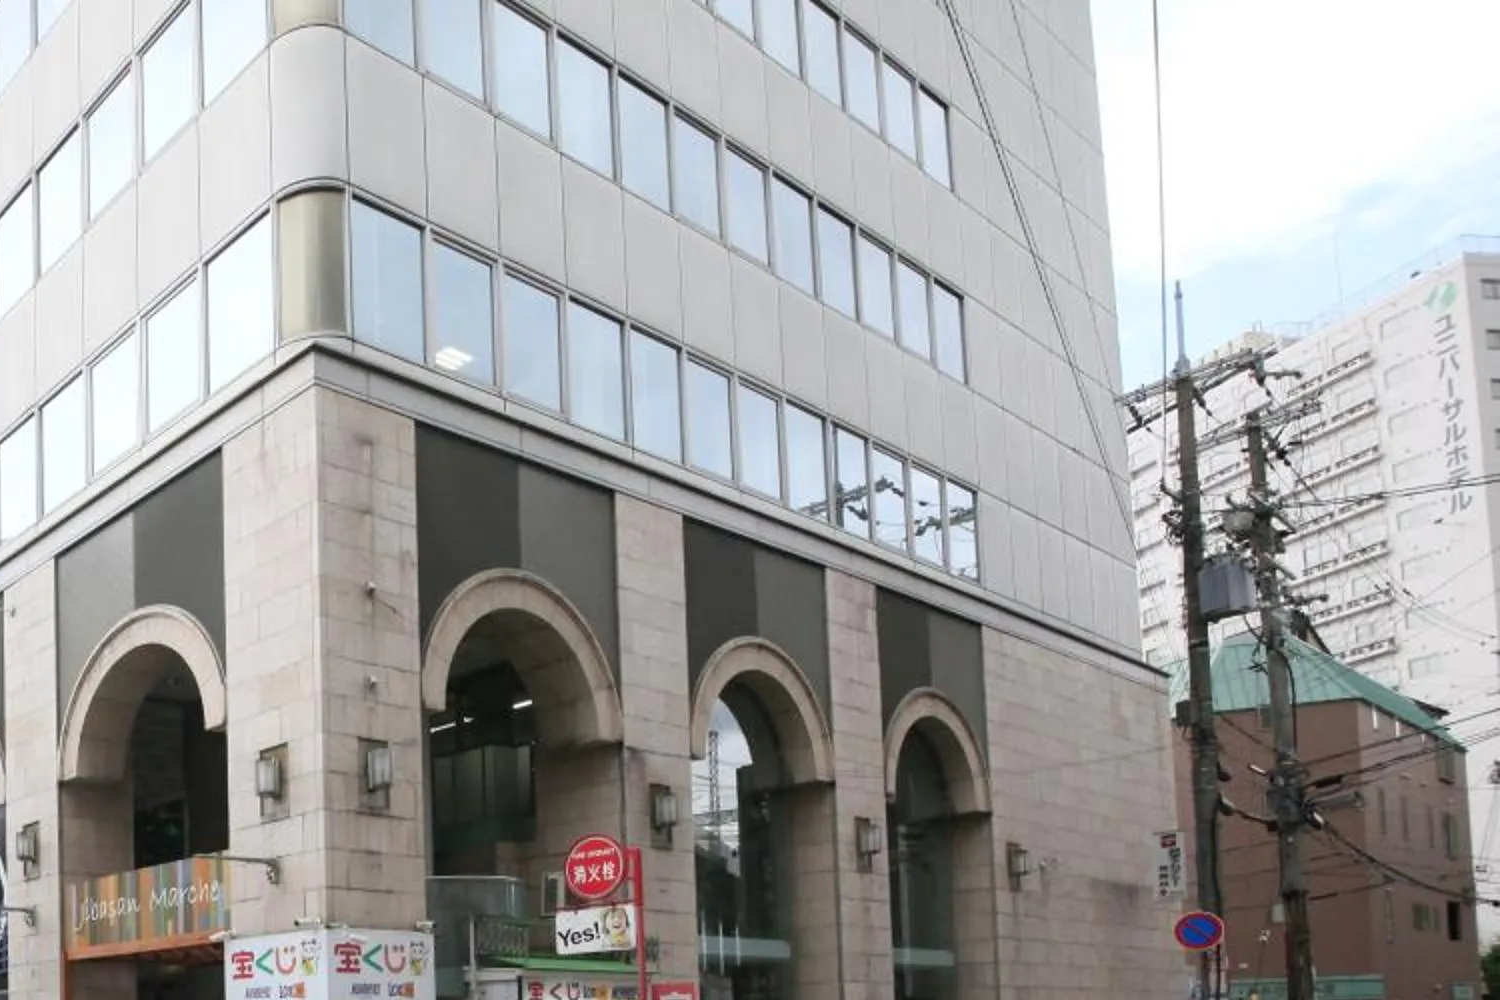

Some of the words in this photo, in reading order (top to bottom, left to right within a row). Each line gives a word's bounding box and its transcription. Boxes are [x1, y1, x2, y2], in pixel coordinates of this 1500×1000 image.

[1434, 314, 1473, 515] ユニバーサルホテル
[573, 861, 616, 885] 消火栓
[558, 921, 601, 947] Yes!
[231, 946, 297, 981] 宝くじ
[334, 942, 406, 974] 宝くじ
